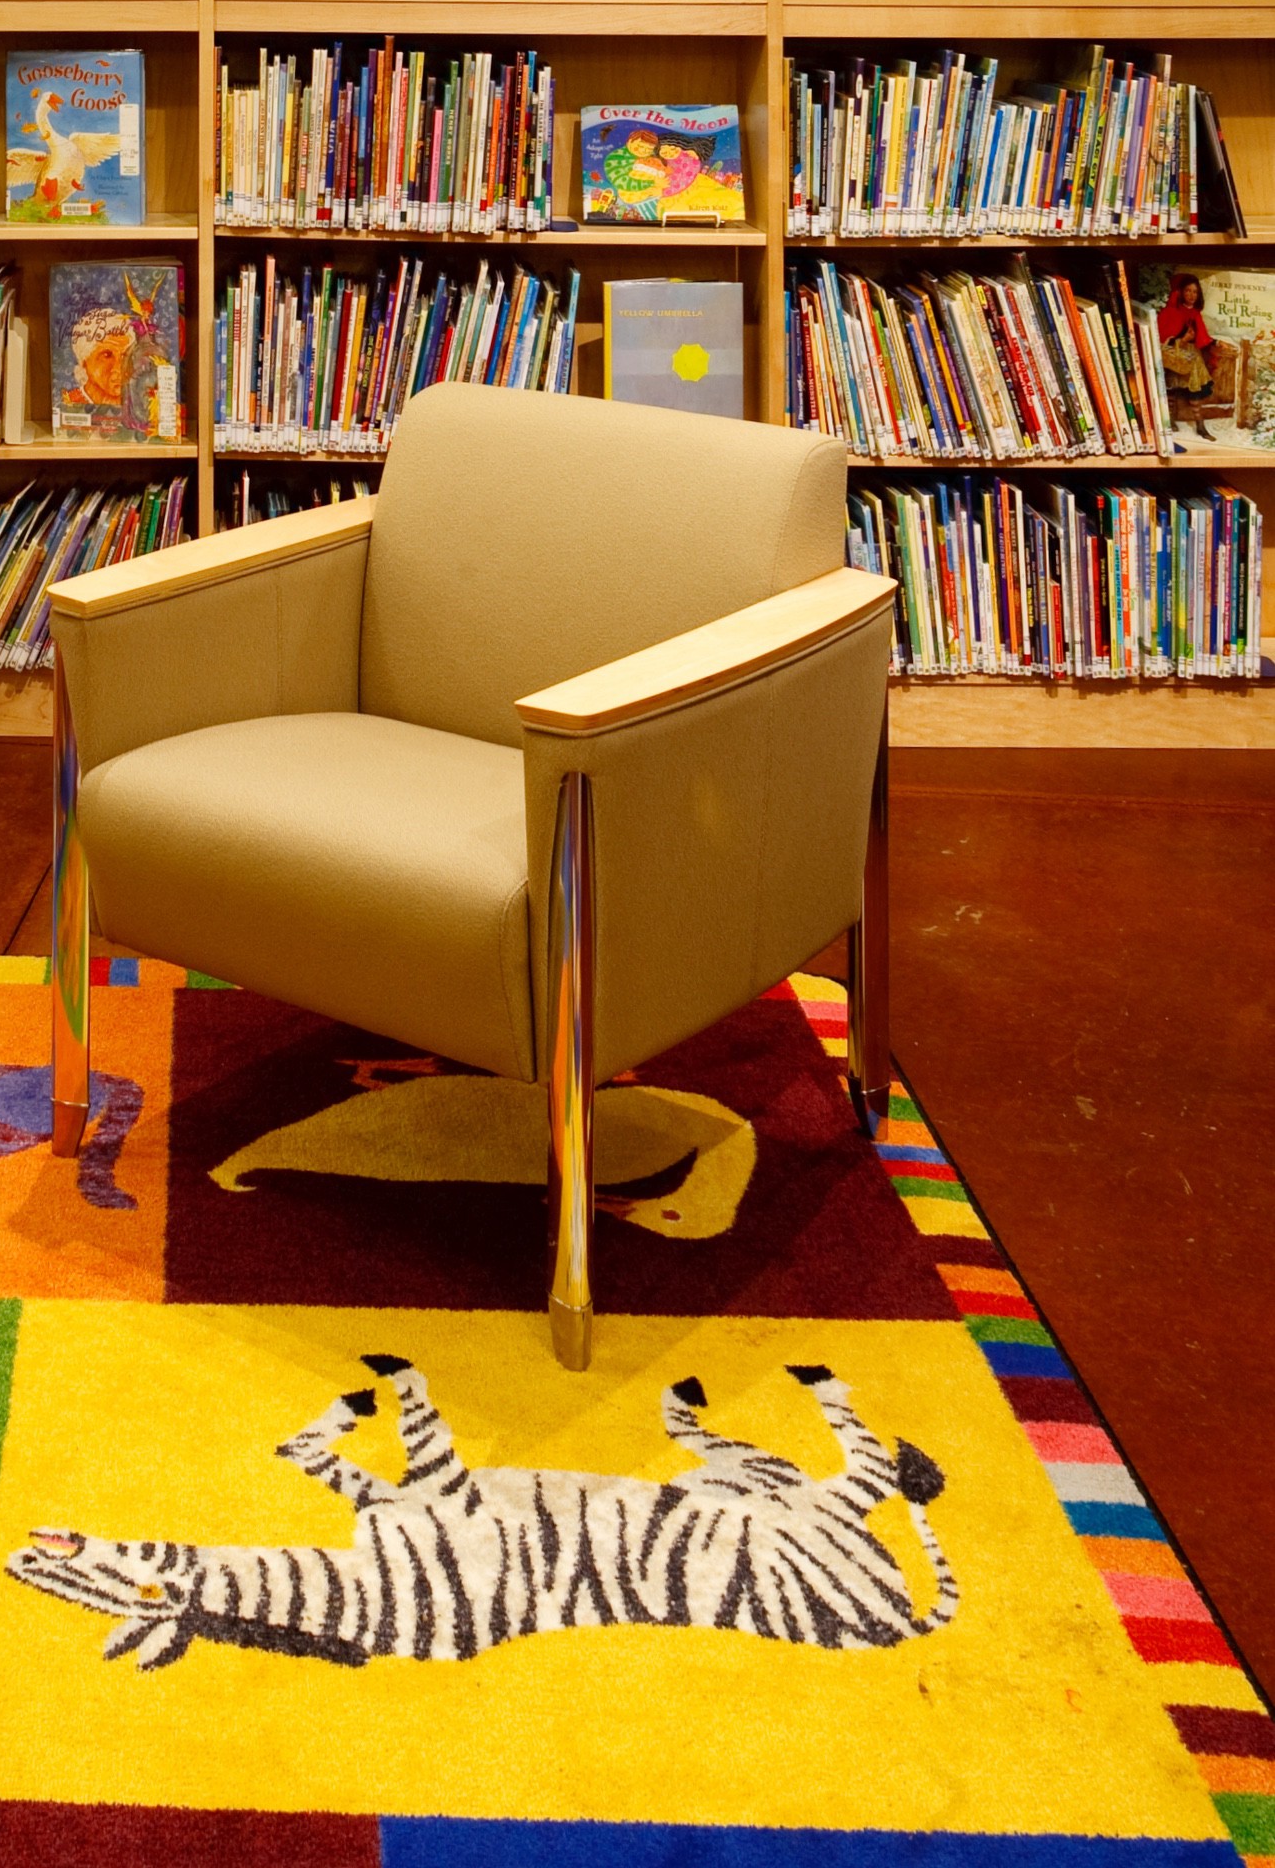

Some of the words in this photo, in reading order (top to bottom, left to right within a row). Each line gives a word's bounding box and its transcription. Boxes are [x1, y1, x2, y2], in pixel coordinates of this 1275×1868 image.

[18, 63, 123, 86] Gooseberry
[600, 107, 642, 120] Over
[646, 110, 674, 126] the
[680, 116, 730, 132] Moon
[1218, 302, 1236, 315] Red
[1224, 291, 1250, 304] Little
[808, 379, 816, 418] MONSTERS
